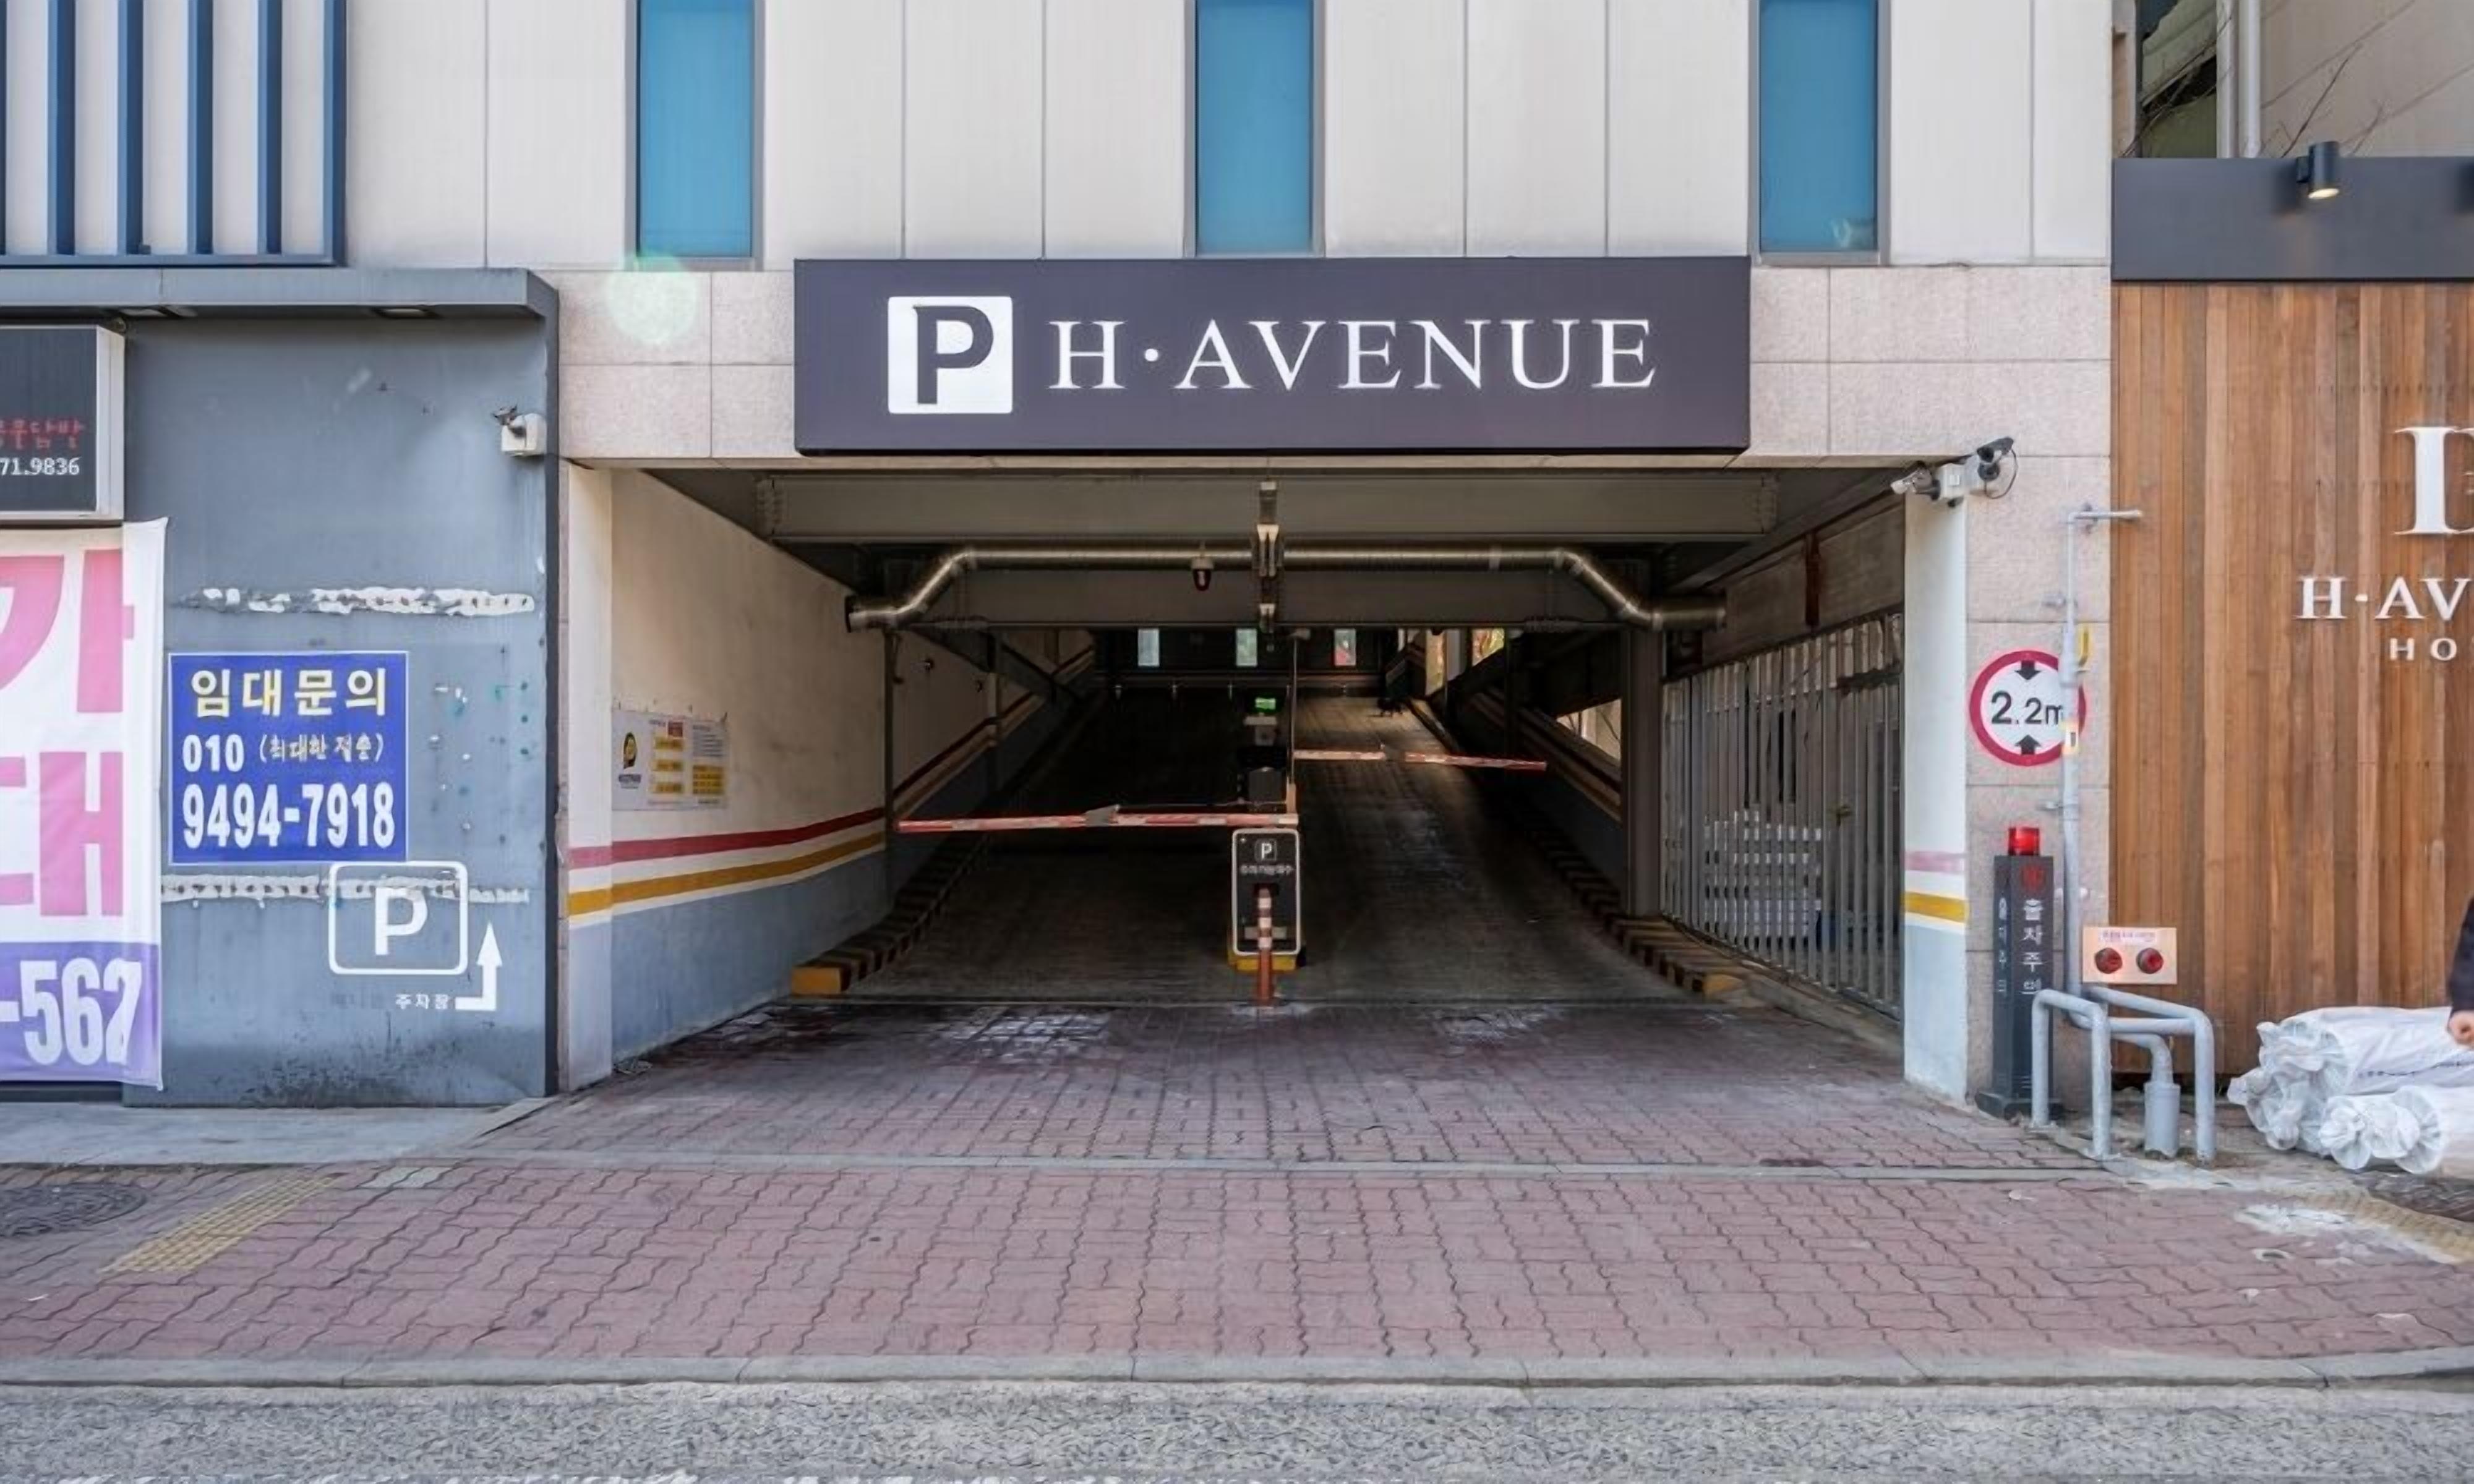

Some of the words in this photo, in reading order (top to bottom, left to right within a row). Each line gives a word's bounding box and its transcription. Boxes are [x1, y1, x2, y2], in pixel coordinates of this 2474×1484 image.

[912, 305, 994, 405] P
[1991, 690, 2063, 725] 2.2m
[182, 734, 245, 772] 010
[182, 782, 395, 848] 9494-7918
[1261, 842, 1272, 860] P
[375, 888, 428, 955] P
